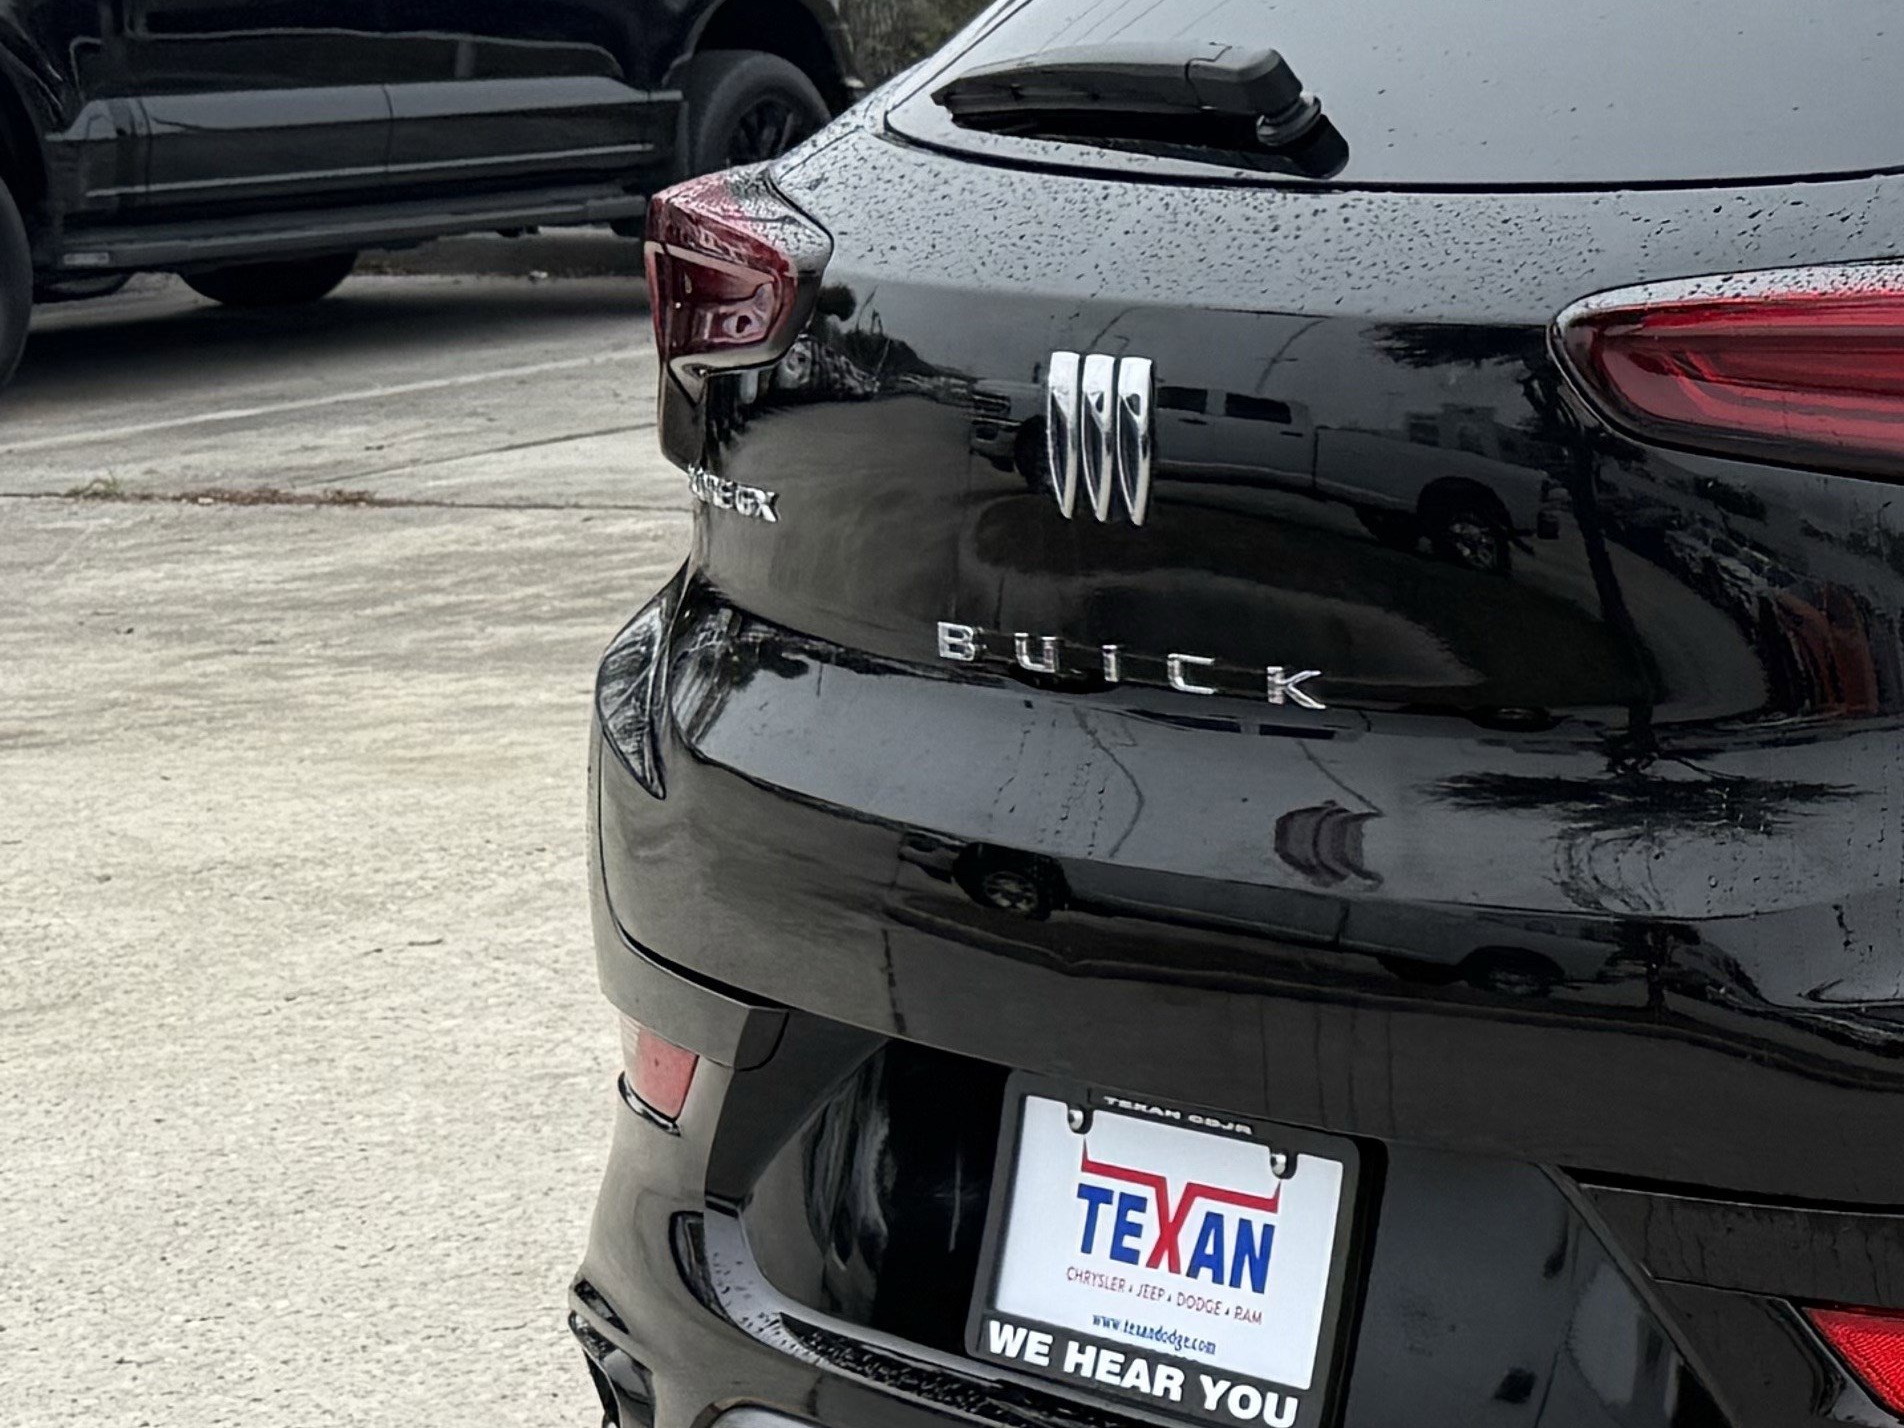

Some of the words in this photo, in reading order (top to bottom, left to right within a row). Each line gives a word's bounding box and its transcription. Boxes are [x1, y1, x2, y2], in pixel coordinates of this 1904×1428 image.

[938, 620, 1327, 711] BUICK
[1103, 1095, 1181, 1120] TEXAN
[1076, 1139, 1281, 1294] TEXAN
[1066, 1266, 1126, 1293] CHRYSLER
[1136, 1283, 1165, 1301] JEEP
[1176, 1291, 1222, 1316] DODGE
[1234, 1305, 1262, 1324] RAM
[987, 1320, 1053, 1366] WE
[1063, 1341, 1185, 1402] HEAR
[1200, 1374, 1298, 1428] YOU
